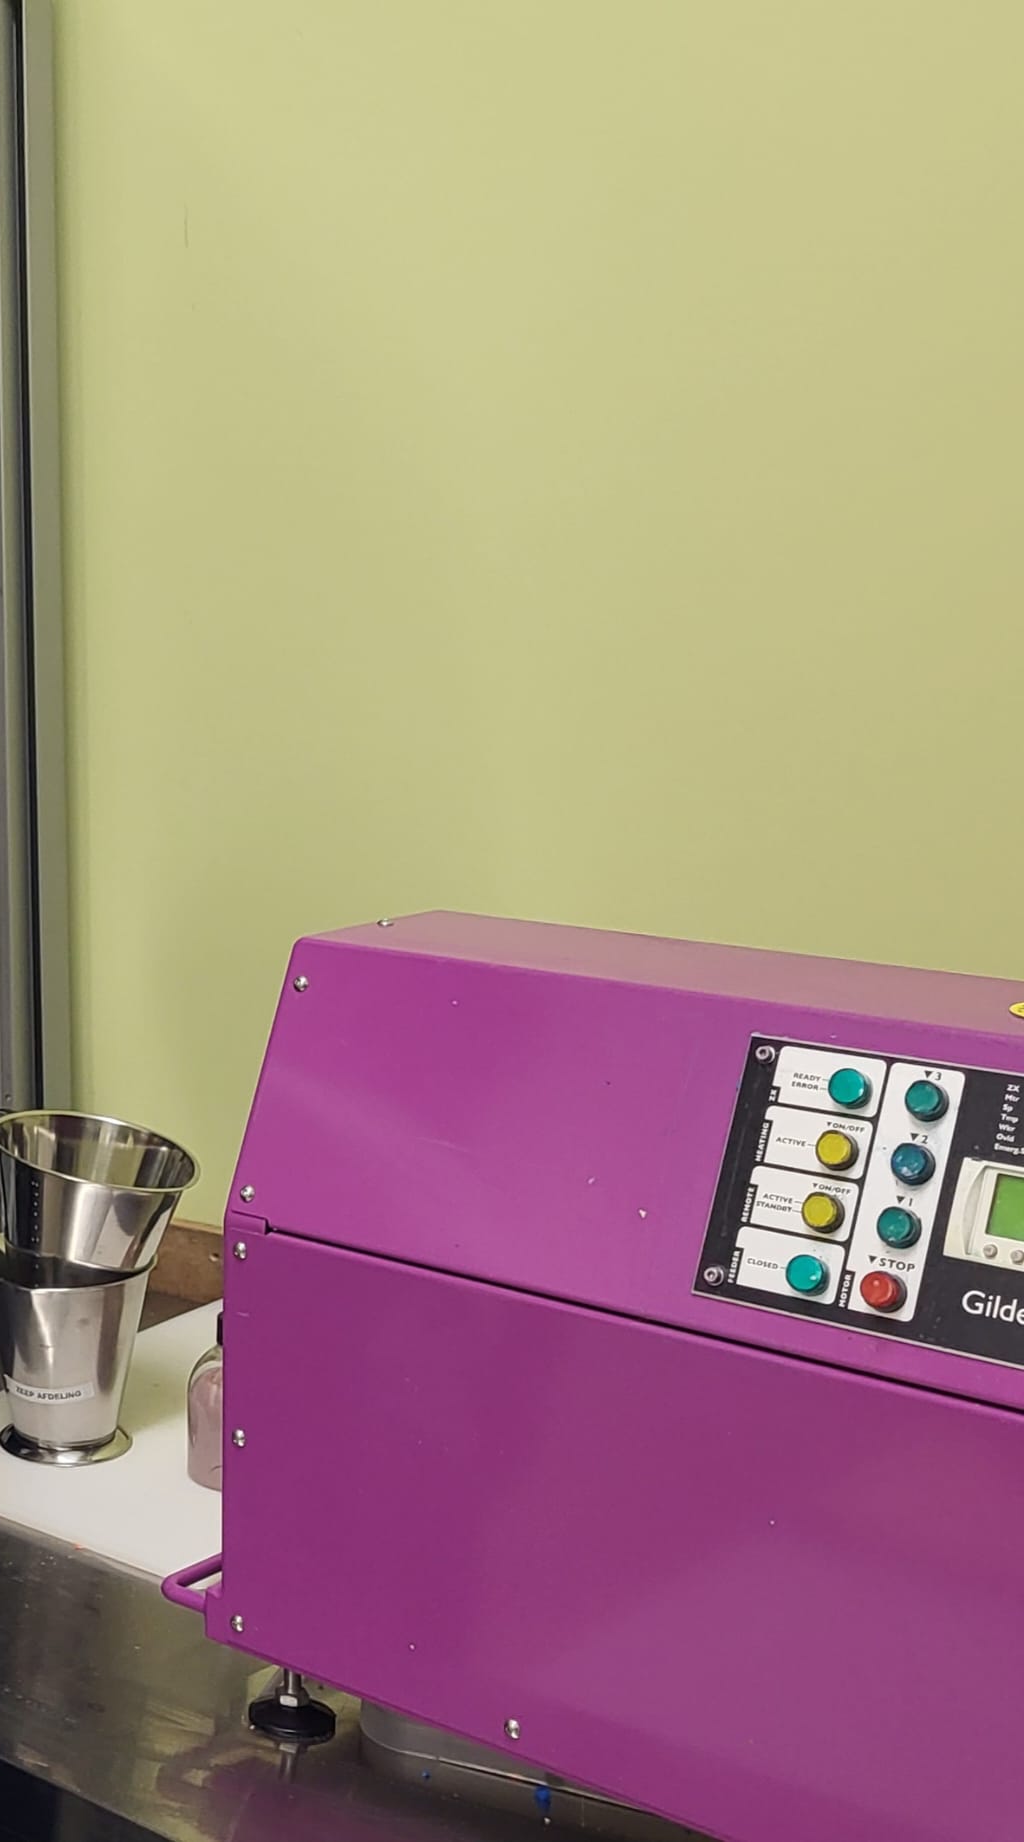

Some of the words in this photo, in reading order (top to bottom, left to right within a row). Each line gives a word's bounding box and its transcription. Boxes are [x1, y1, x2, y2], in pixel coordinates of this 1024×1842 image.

[793, 1072, 822, 1082] READY
[934, 1072, 942, 1081] 3
[791, 1081, 819, 1091] ERROR
[1006, 1084, 1020, 1093] ZX
[769, 1089, 777, 1102] ZX
[1002, 1103, 1014, 1113] Sp
[832, 1122, 865, 1133] ON/OFF
[755, 1122, 770, 1162] HEATING
[775, 1137, 807, 1147] ACTIVE
[921, 1135, 928, 1144] 2
[818, 1183, 851, 1195] ON/OFF
[763, 1193, 793, 1204] ACTIVE
[740, 1187, 755, 1223] REMOTE
[756, 1200, 793, 1213] STANDBY
[727, 1251, 741, 1283] FEEDER
[746, 1258, 779, 1269] CLOSED
[879, 1258, 915, 1272] STOP
[838, 1274, 852, 1307] MOTOR
[962, 1290, 1024, 1325] Gilde
[37, 1390, 82, 1401] AFDELING
